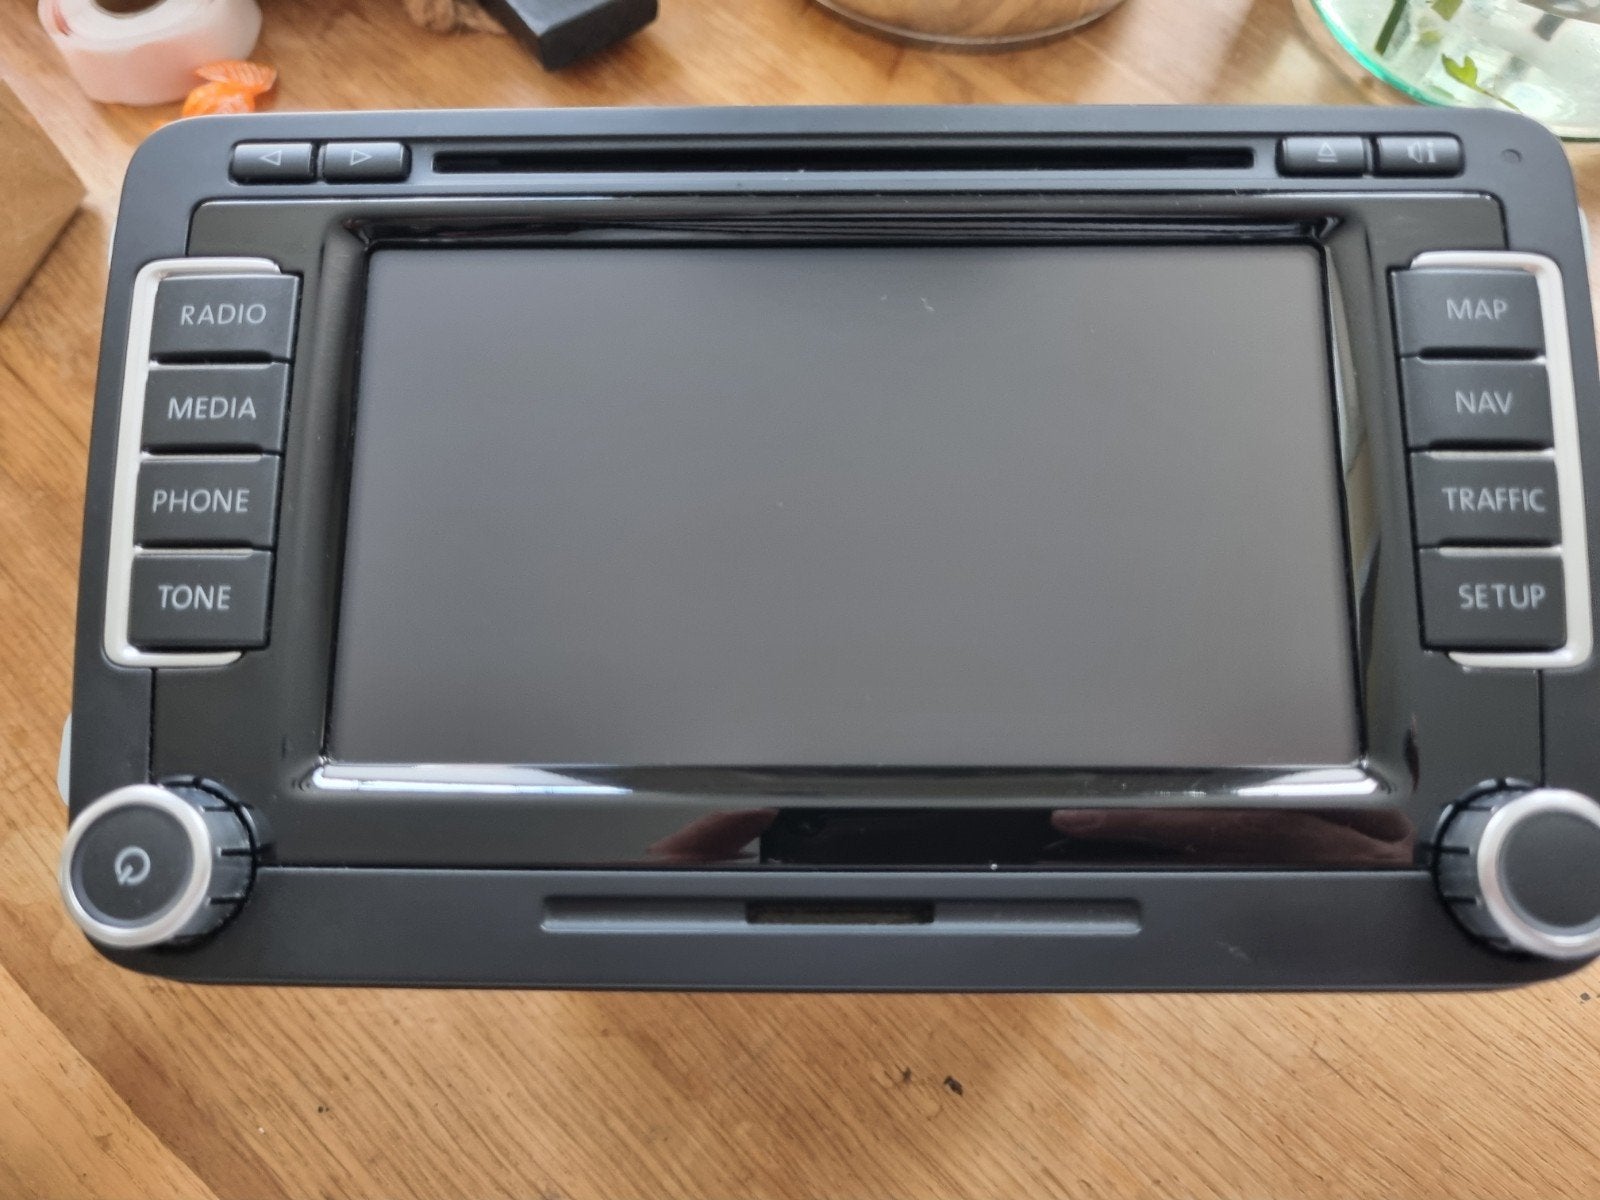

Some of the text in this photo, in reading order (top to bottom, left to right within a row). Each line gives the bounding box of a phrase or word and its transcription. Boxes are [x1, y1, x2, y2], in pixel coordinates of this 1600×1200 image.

[180, 303, 267, 326] RADIO
[1446, 297, 1508, 321] MAP
[167, 396, 257, 421] MEDIA
[1455, 390, 1513, 415] NAV
[152, 488, 250, 514] PHONE
[1441, 486, 1546, 513] TRAFFIC
[158, 584, 233, 611] TONE
[1458, 583, 1547, 610] SETUP
